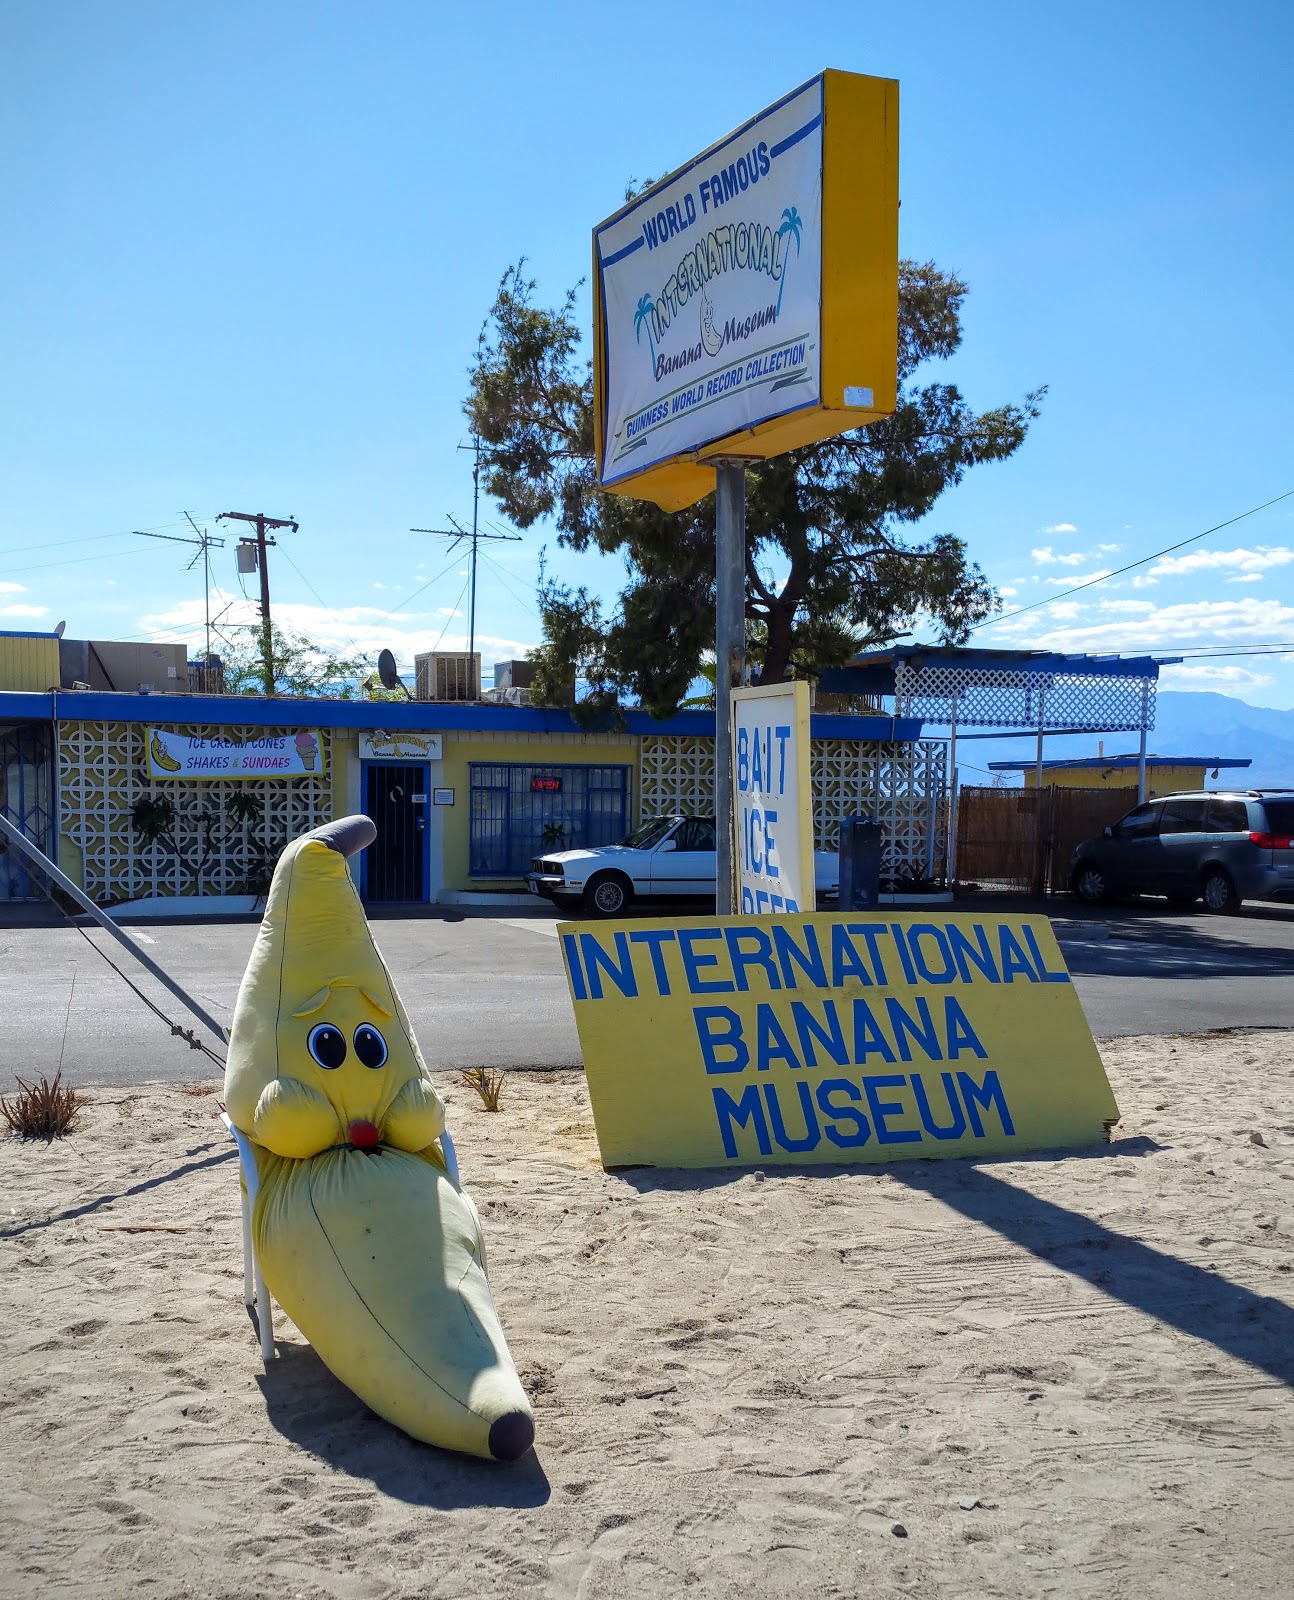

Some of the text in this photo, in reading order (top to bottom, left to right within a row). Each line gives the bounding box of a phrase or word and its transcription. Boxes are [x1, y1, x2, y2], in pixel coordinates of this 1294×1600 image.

[642, 141, 771, 251] WORLD FAMOUS
[650, 222, 782, 344] INTERNATIONAL
[655, 304, 776, 382] Banana Museum
[626, 342, 806, 439] GUINNESS WORLD RECORD COLLECTION
[186, 756, 291, 769] SHAKES & SUNDAES
[188, 737, 286, 749] ICE CREAM CONES
[737, 725, 791, 795] BAIT
[532, 778, 560, 790] OPEN
[743, 807, 780, 879] ICE
[563, 922, 1071, 1000] INTERNATIONAL
[693, 995, 989, 1075] BANANA
[712, 1070, 1016, 1159] MUSEUM
